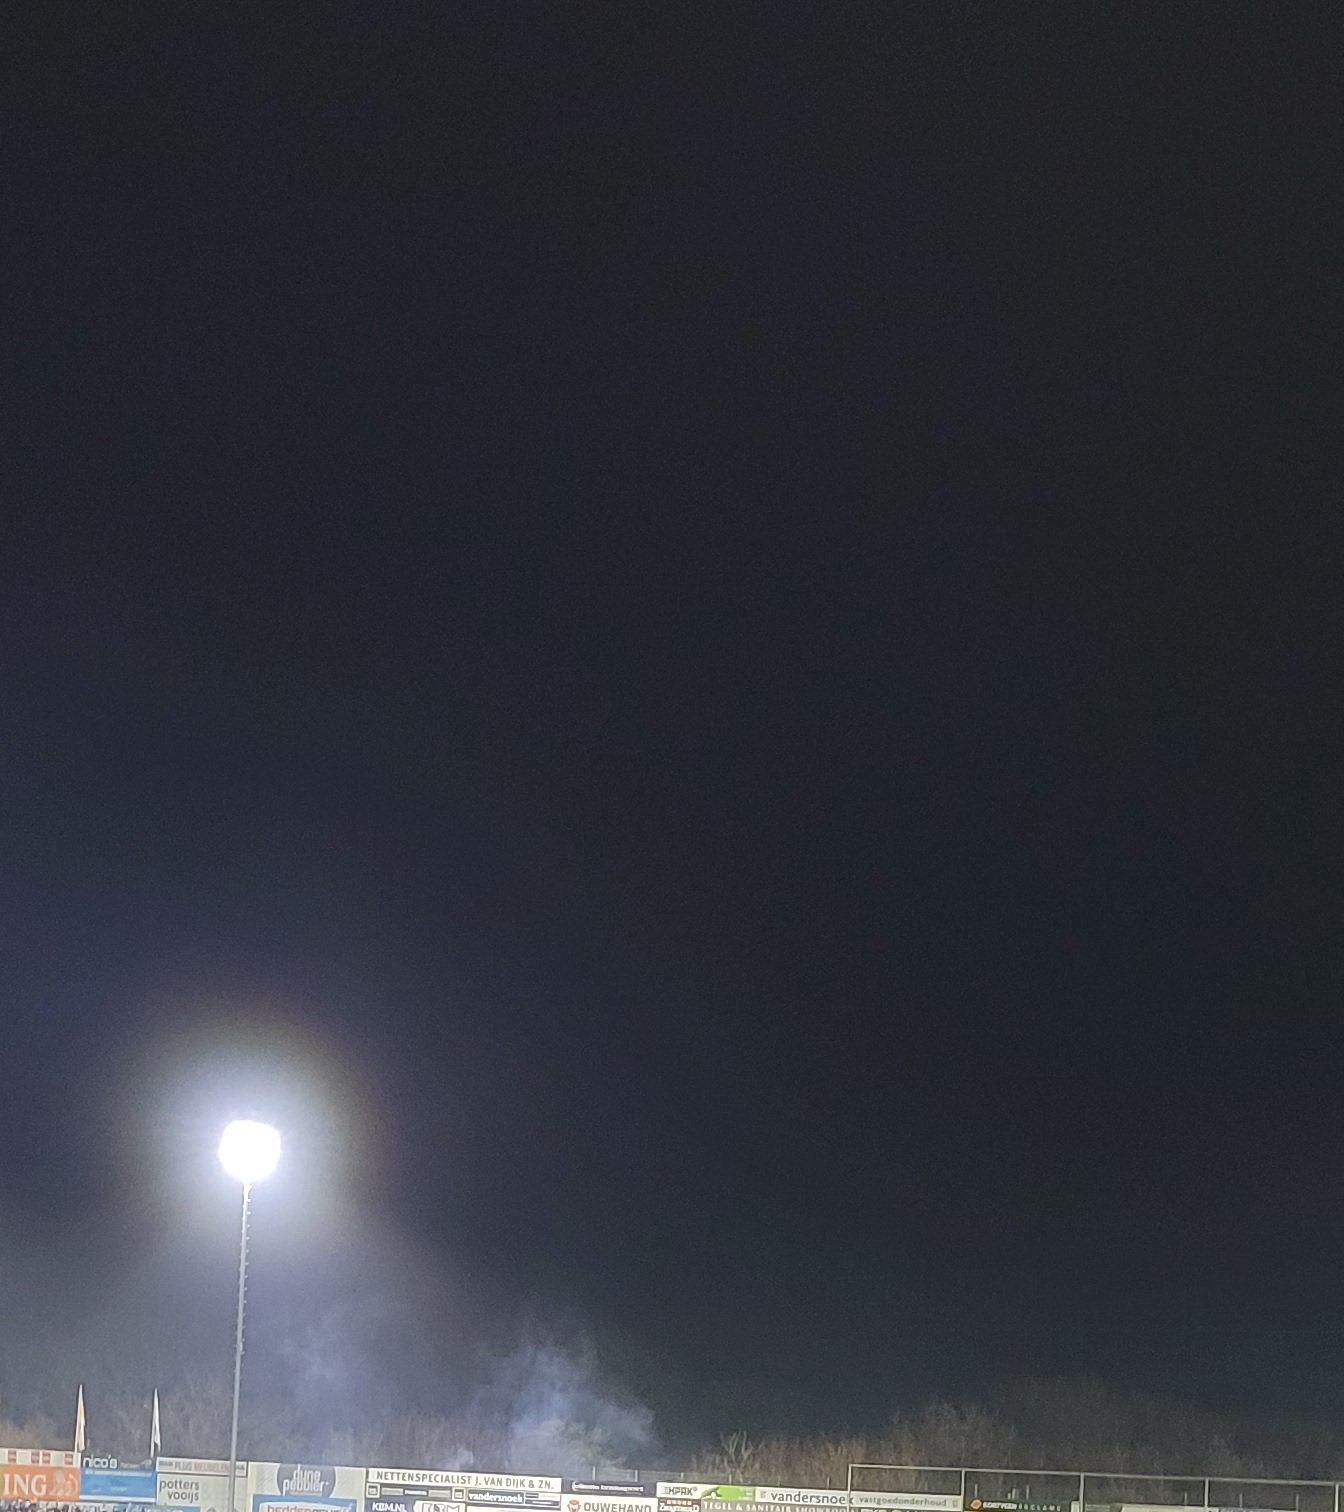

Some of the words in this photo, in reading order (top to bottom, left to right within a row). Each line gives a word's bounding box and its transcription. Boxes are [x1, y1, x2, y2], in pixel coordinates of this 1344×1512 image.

[82, 1454, 118, 1470] nico's
[2, 1473, 47, 1497] ING
[159, 1478, 200, 1494] potters
[376, 1470, 473, 1485] NETTENSPECIALIST
[484, 1476, 503, 1487] VAN
[505, 1478, 526, 1488] DIJK
[167, 1489, 200, 1504] vooijs
